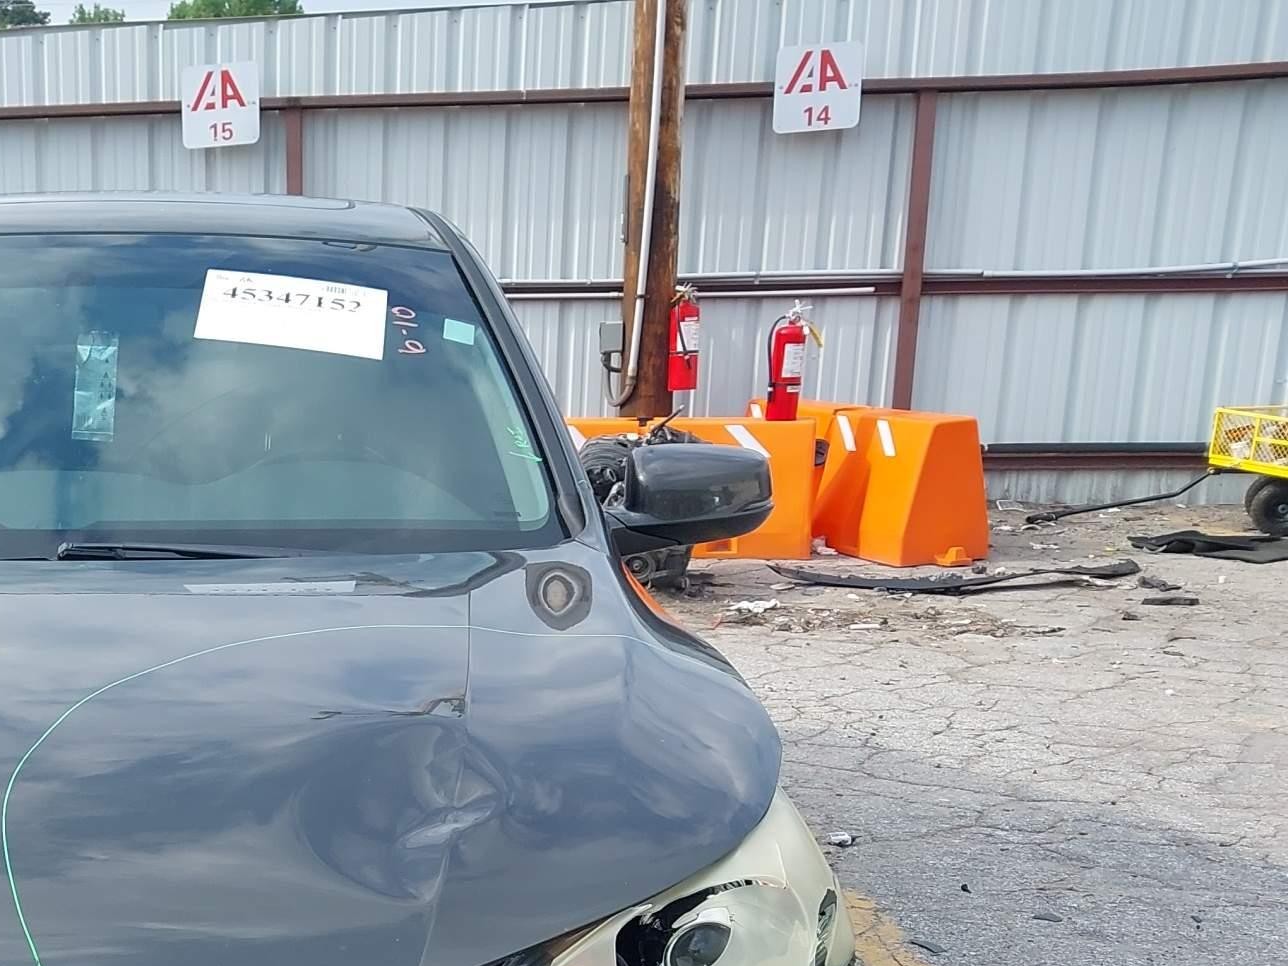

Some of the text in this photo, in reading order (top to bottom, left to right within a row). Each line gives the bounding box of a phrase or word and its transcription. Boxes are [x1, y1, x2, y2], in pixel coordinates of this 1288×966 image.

[803, 105, 831, 127] 14
[209, 121, 234, 142] 15
[223, 286, 361, 313] 45347152
